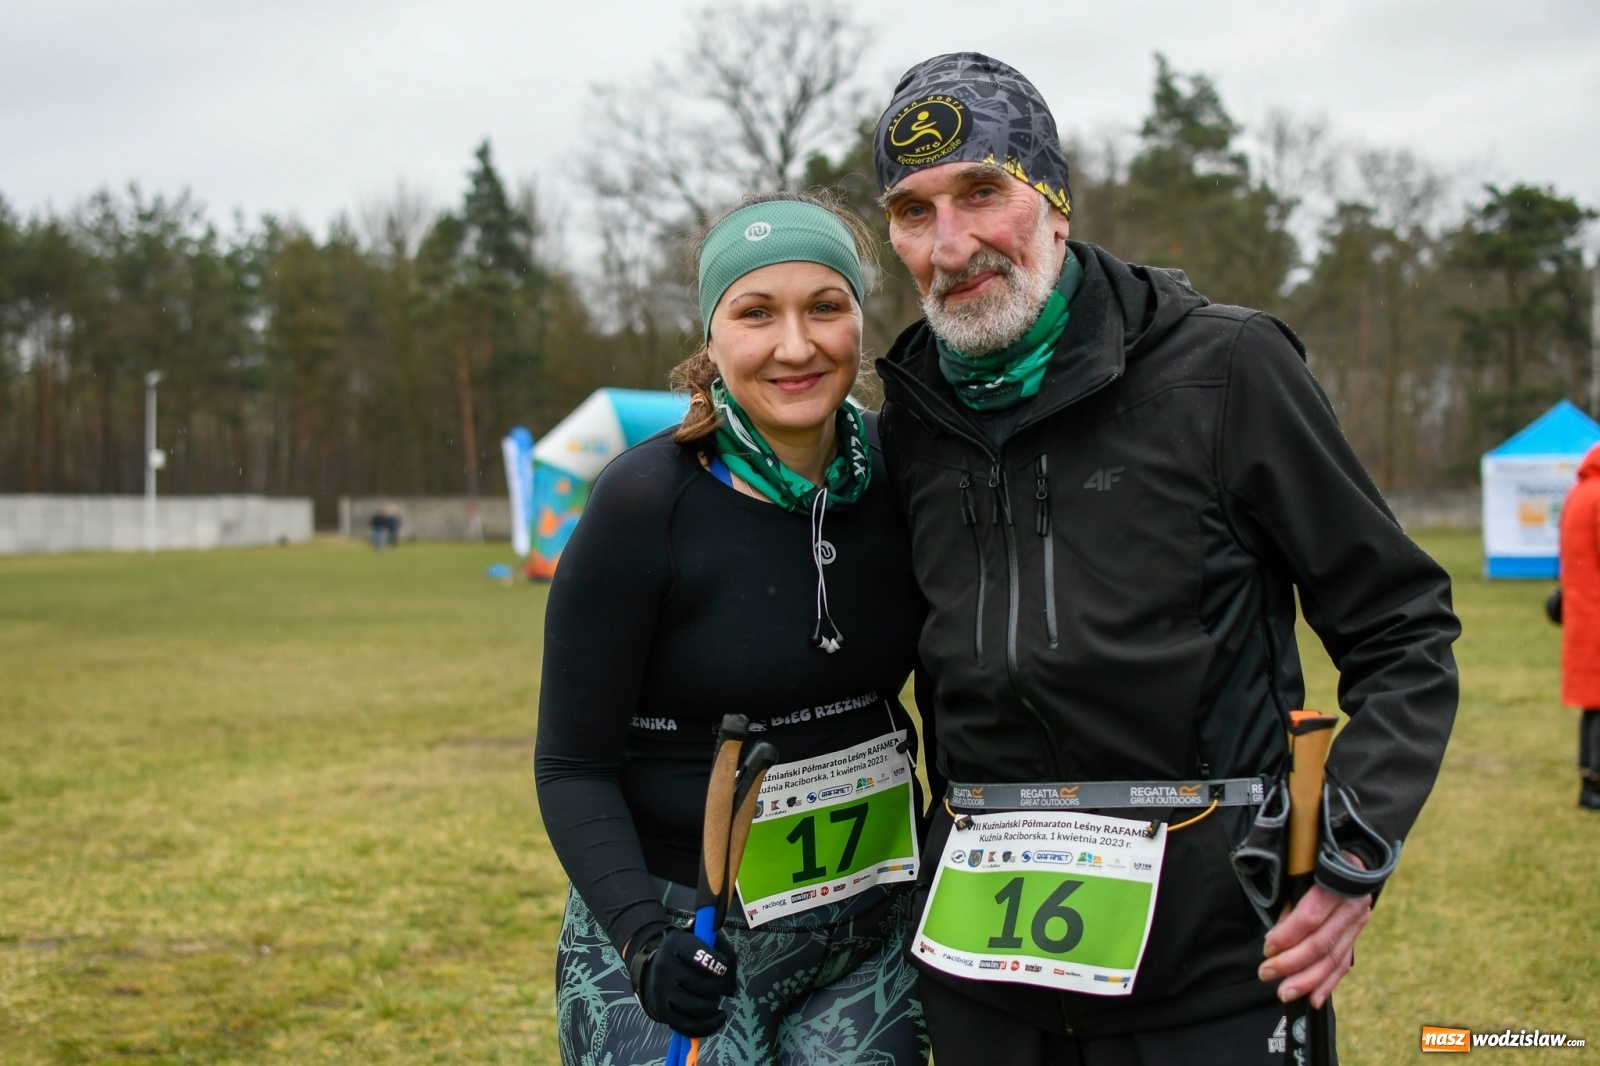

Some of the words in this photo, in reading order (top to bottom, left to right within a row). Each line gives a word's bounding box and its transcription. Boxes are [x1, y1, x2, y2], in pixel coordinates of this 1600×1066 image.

[914, 143, 932, 154] XYZ
[1083, 466, 1125, 492] 4F
[802, 757, 848, 775] Półmaraton
[848, 750, 867, 763] Leśny
[759, 785, 783, 795] uźnia
[785, 773, 829, 789] Raciborska,
[836, 762, 867, 777] kwietnia
[867, 755, 884, 768] 2023
[821, 785, 851, 798] RAFAMET
[1020, 789, 1059, 798] REGATTA
[1130, 786, 1177, 797] REGATTA
[1020, 798, 1040, 806] GREAT
[1040, 798, 1080, 807] OUTDOORS
[1130, 796, 1159, 804] GREAT
[1160, 796, 1202, 804] OUTDOORS
[981, 818, 1020, 831] Kuźniański
[1021, 819, 1072, 829] Półmaraton
[1074, 820, 1101, 834] Leśny
[786, 802, 869, 884] 17
[978, 833, 1002, 843] Kuźnia
[1003, 831, 1048, 841] Raciborska,
[1056, 832, 1097, 845] kwietnia
[1099, 836, 1124, 848] 2023
[1036, 852, 1070, 862] RAFAMET
[987, 876, 1084, 954] 16
